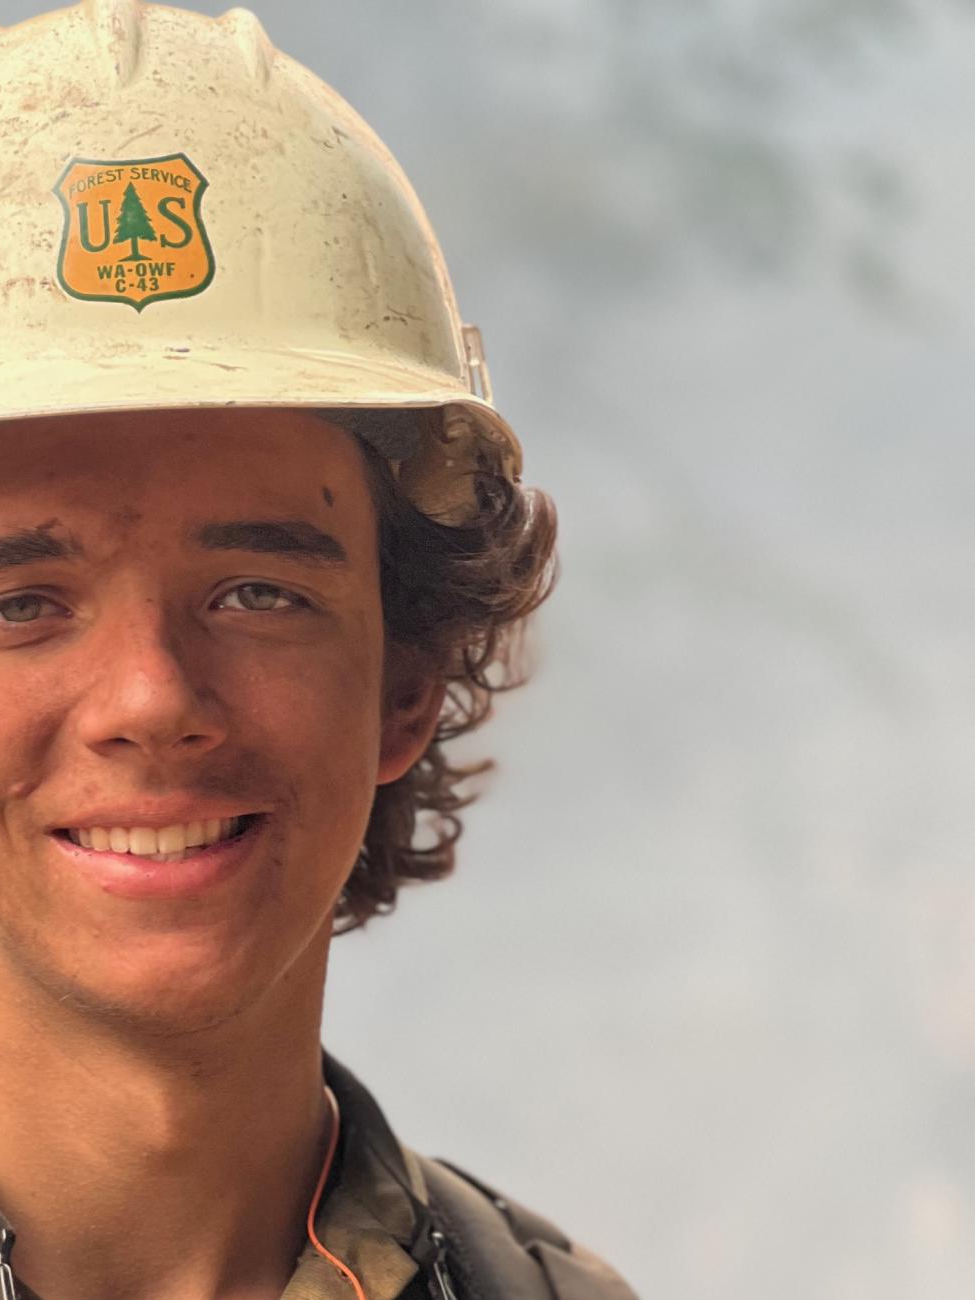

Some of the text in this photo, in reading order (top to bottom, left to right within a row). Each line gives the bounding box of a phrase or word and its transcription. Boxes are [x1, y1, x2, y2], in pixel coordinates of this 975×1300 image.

[68, 167, 192, 198] FOREST SERVICE
[76, 196, 193, 253] U S
[97, 262, 176, 280] WA-OWF
[115, 277, 160, 293] C-43
